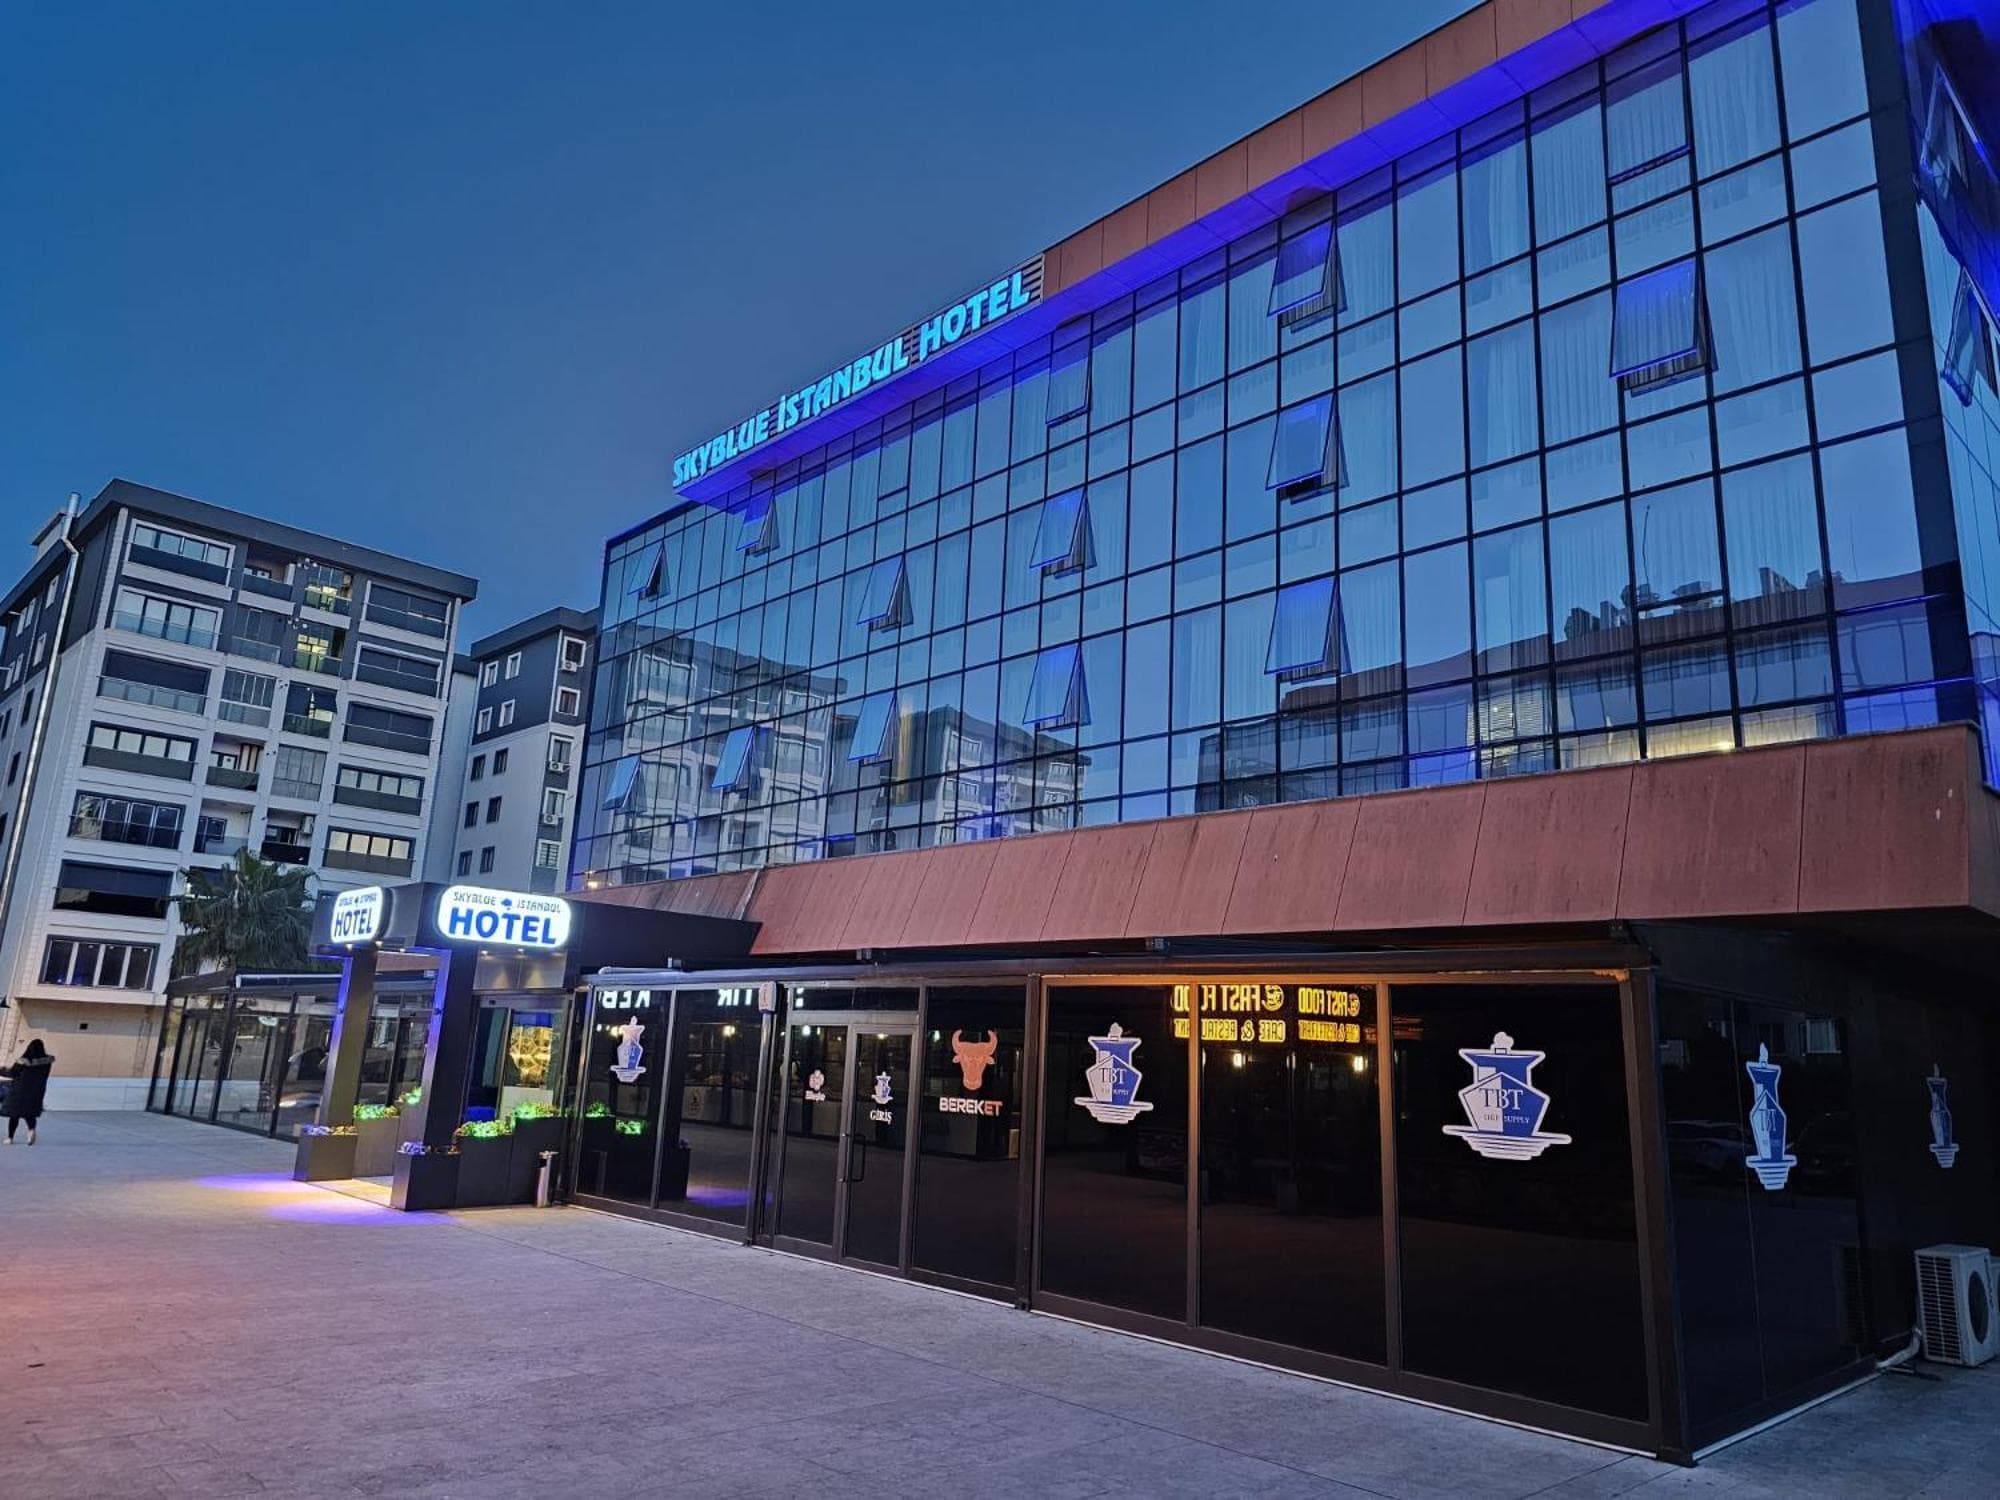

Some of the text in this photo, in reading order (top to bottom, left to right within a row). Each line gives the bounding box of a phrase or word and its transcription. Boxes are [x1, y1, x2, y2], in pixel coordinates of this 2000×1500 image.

[673, 410, 771, 488] SKYBLUE
[919, 270, 1031, 362] HOTEL
[453, 891, 497, 906] SKYBLUE
[334, 908, 372, 937] HOTEL
[448, 907, 557, 945] HOTEL
[1098, 1067, 1127, 1084] TBT
[939, 1096, 1003, 1117] BEREKET
[1479, 1087, 1523, 1110] TBT
